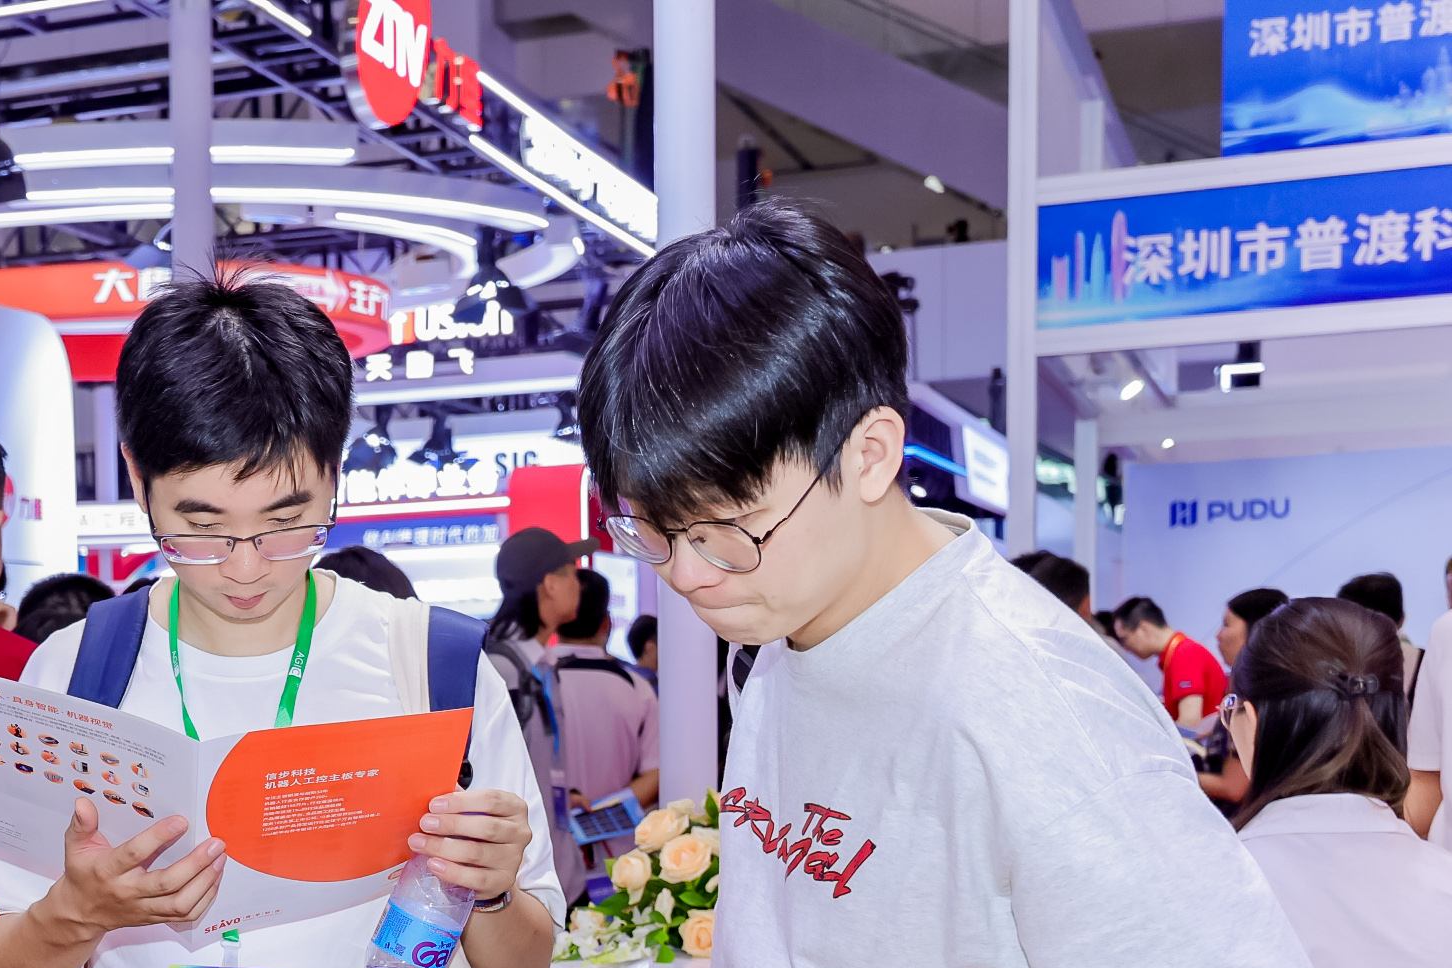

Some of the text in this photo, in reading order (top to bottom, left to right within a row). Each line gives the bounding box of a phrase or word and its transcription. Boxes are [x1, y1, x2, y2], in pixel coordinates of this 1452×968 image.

[1248, 0, 1452, 57] 深圳市普渡
[1207, 498, 1290, 523] PUDU
[288, 650, 305, 678] AGIC
[265, 768, 316, 781] 信步科技
[265, 768, 380, 790] 机器人工控主板专家
